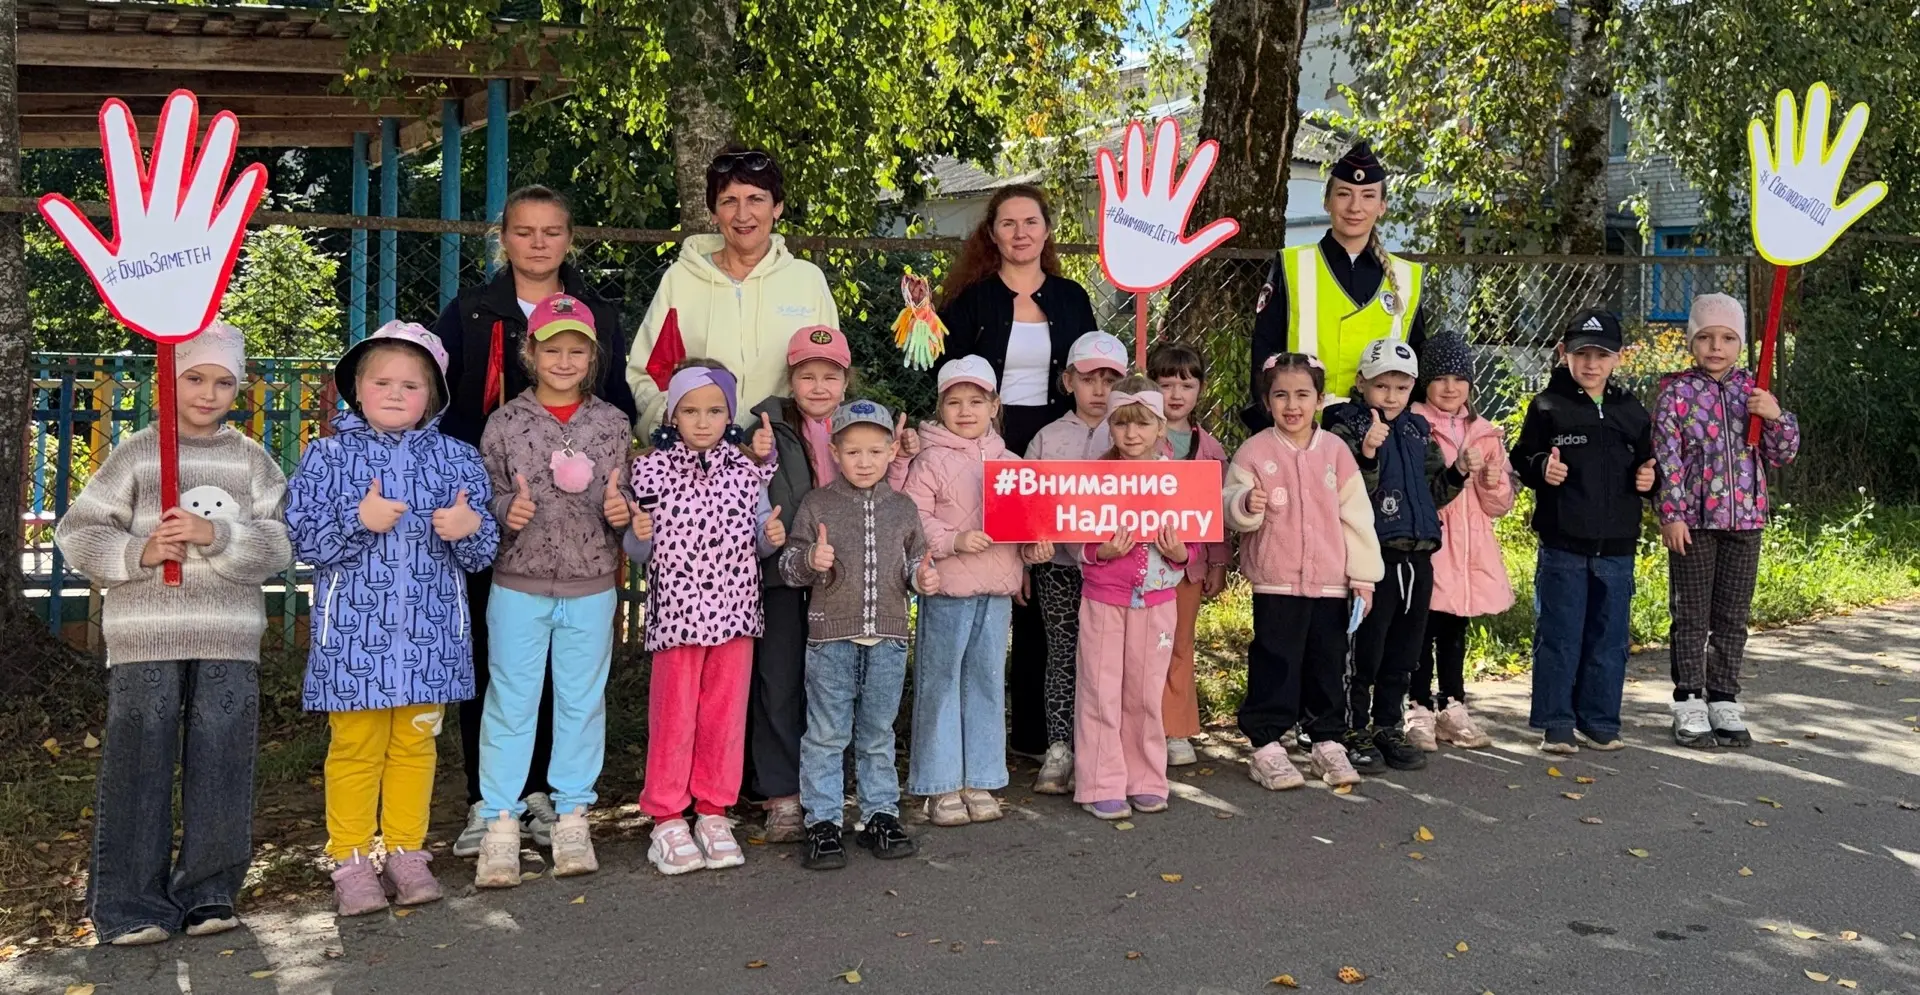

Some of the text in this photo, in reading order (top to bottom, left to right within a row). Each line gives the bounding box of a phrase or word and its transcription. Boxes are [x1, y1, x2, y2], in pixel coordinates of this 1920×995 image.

[1551, 434, 1588, 446] didas
[993, 467, 1178, 496] #Внимание
[1056, 504, 1213, 537] НаДорогу
